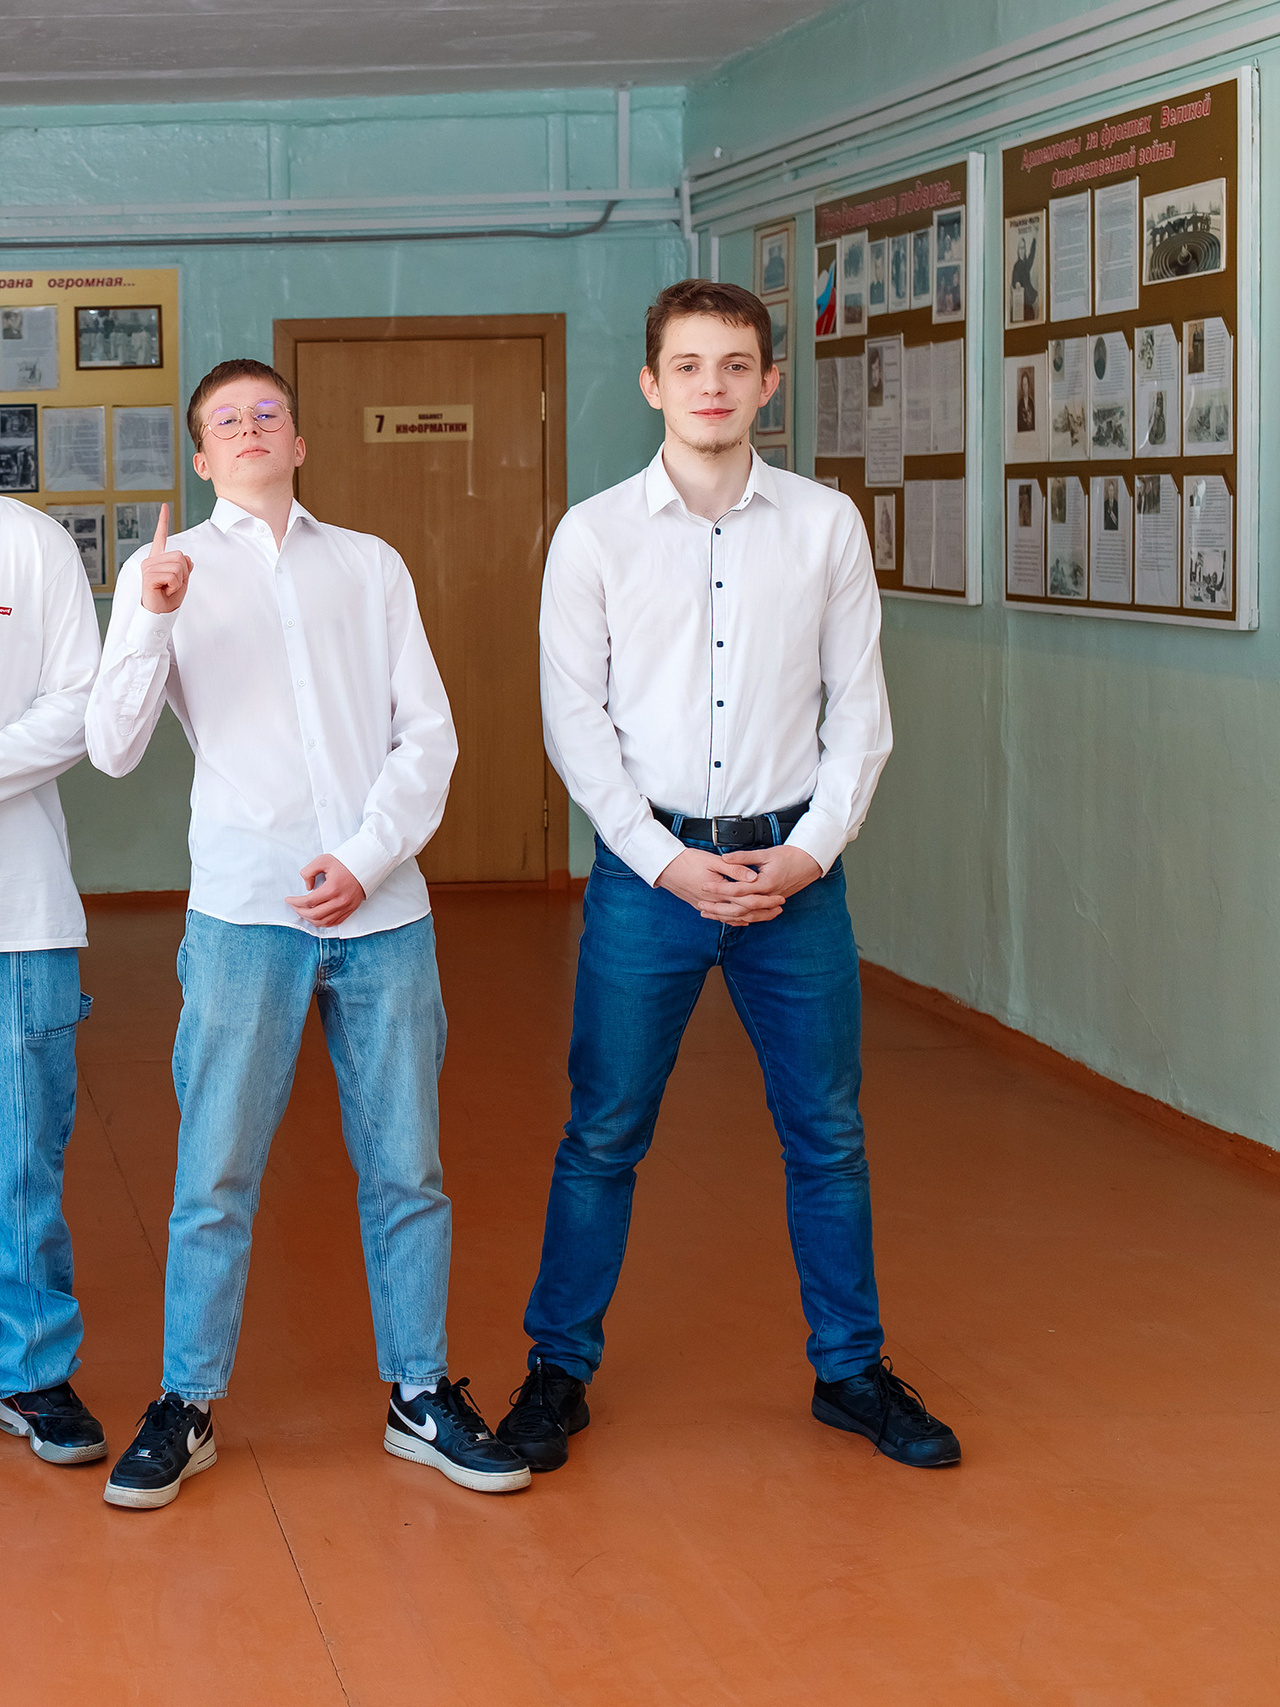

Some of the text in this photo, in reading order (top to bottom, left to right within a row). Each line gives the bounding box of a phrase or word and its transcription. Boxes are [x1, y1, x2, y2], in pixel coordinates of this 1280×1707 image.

[1085, 132, 1099, 150] на
[1100, 123, 1152, 151] фронтах
[1160, 92, 1211, 129] Великой
[1051, 139, 1176, 189] Отечественной войны
[375, 414, 385, 433] 7
[396, 422, 467, 434] ИНФОРМАТИКИ
